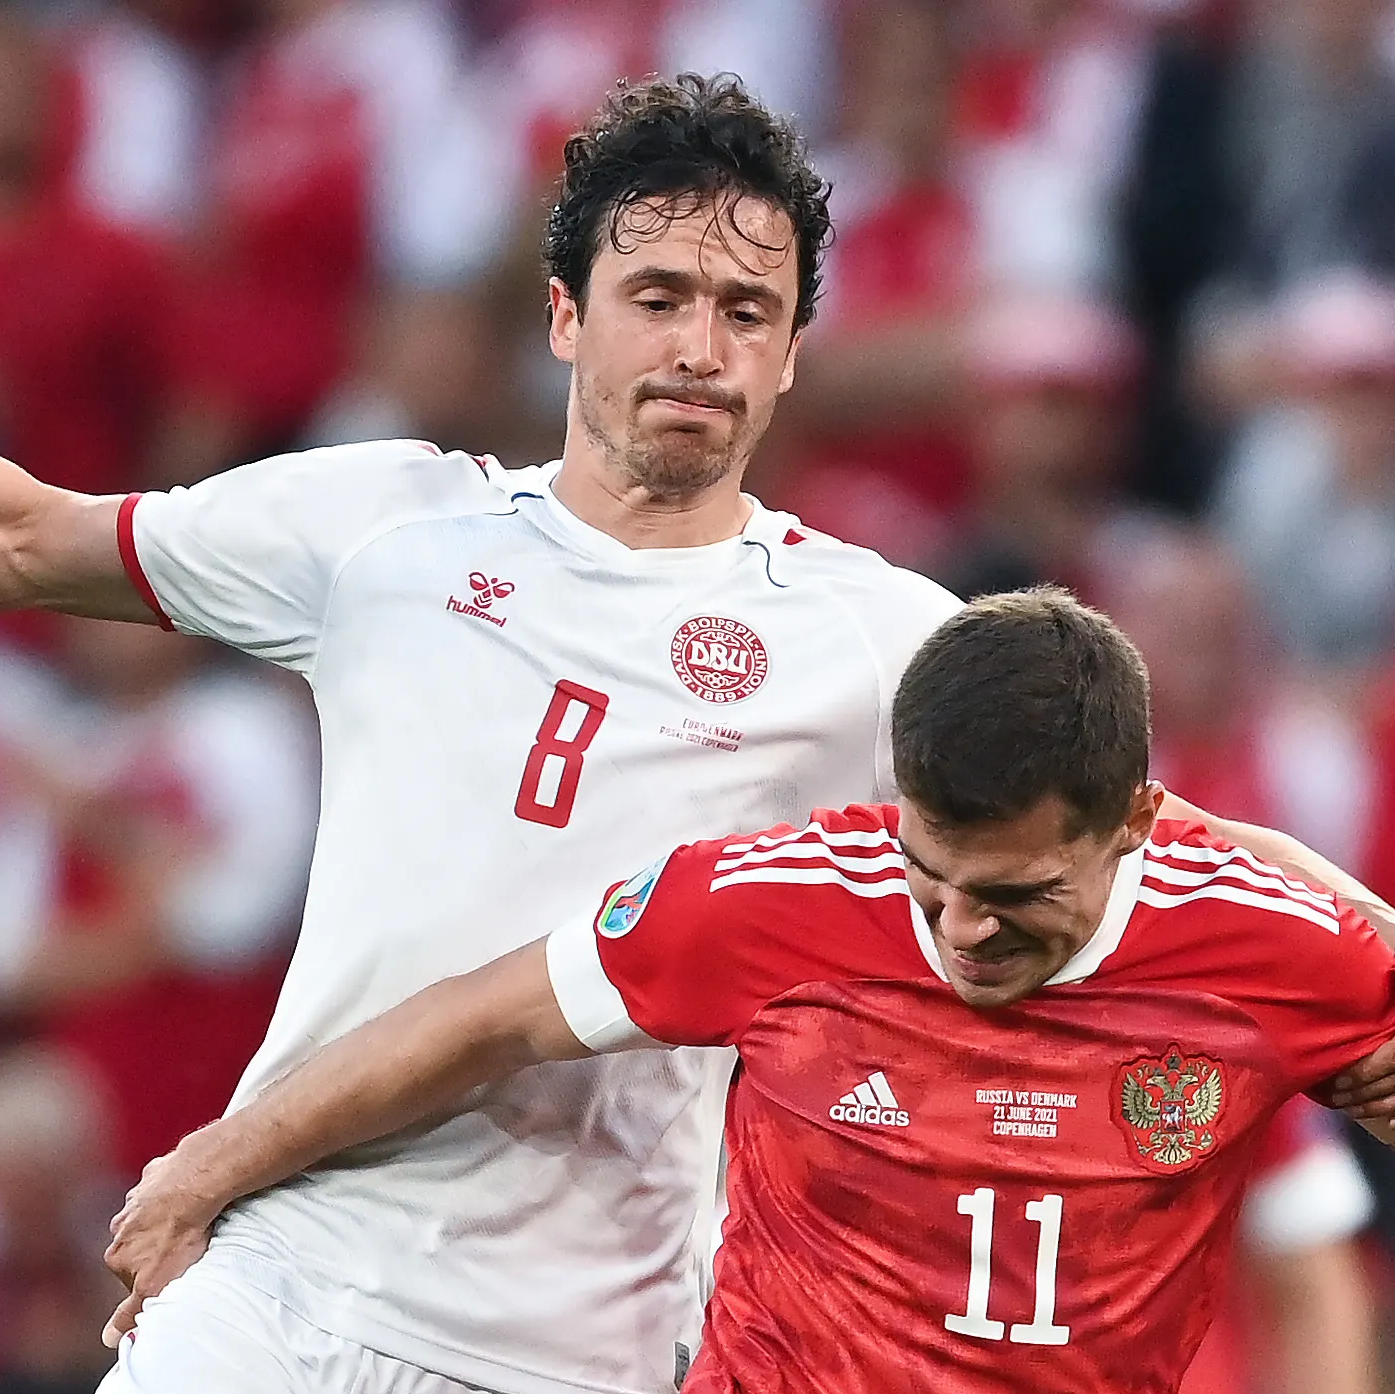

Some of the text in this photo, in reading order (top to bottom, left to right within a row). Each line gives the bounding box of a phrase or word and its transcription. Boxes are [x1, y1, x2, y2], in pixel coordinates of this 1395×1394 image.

[446, 594, 507, 627] hummel
[671, 629, 690, 686] DANSK
[740, 649, 767, 695] UNION
[687, 640, 749, 675] DBU
[694, 686, 738, 702] 1889
[513, 678, 610, 829] 8
[975, 1089, 1078, 1108] RUSSIA VS DENMARK
[829, 1103, 910, 1127] adidas
[993, 1105, 1058, 1122] 21 JUNE 2021
[993, 1121, 1057, 1138] COPENHAGEN
[944, 1187, 1070, 1346] 11
